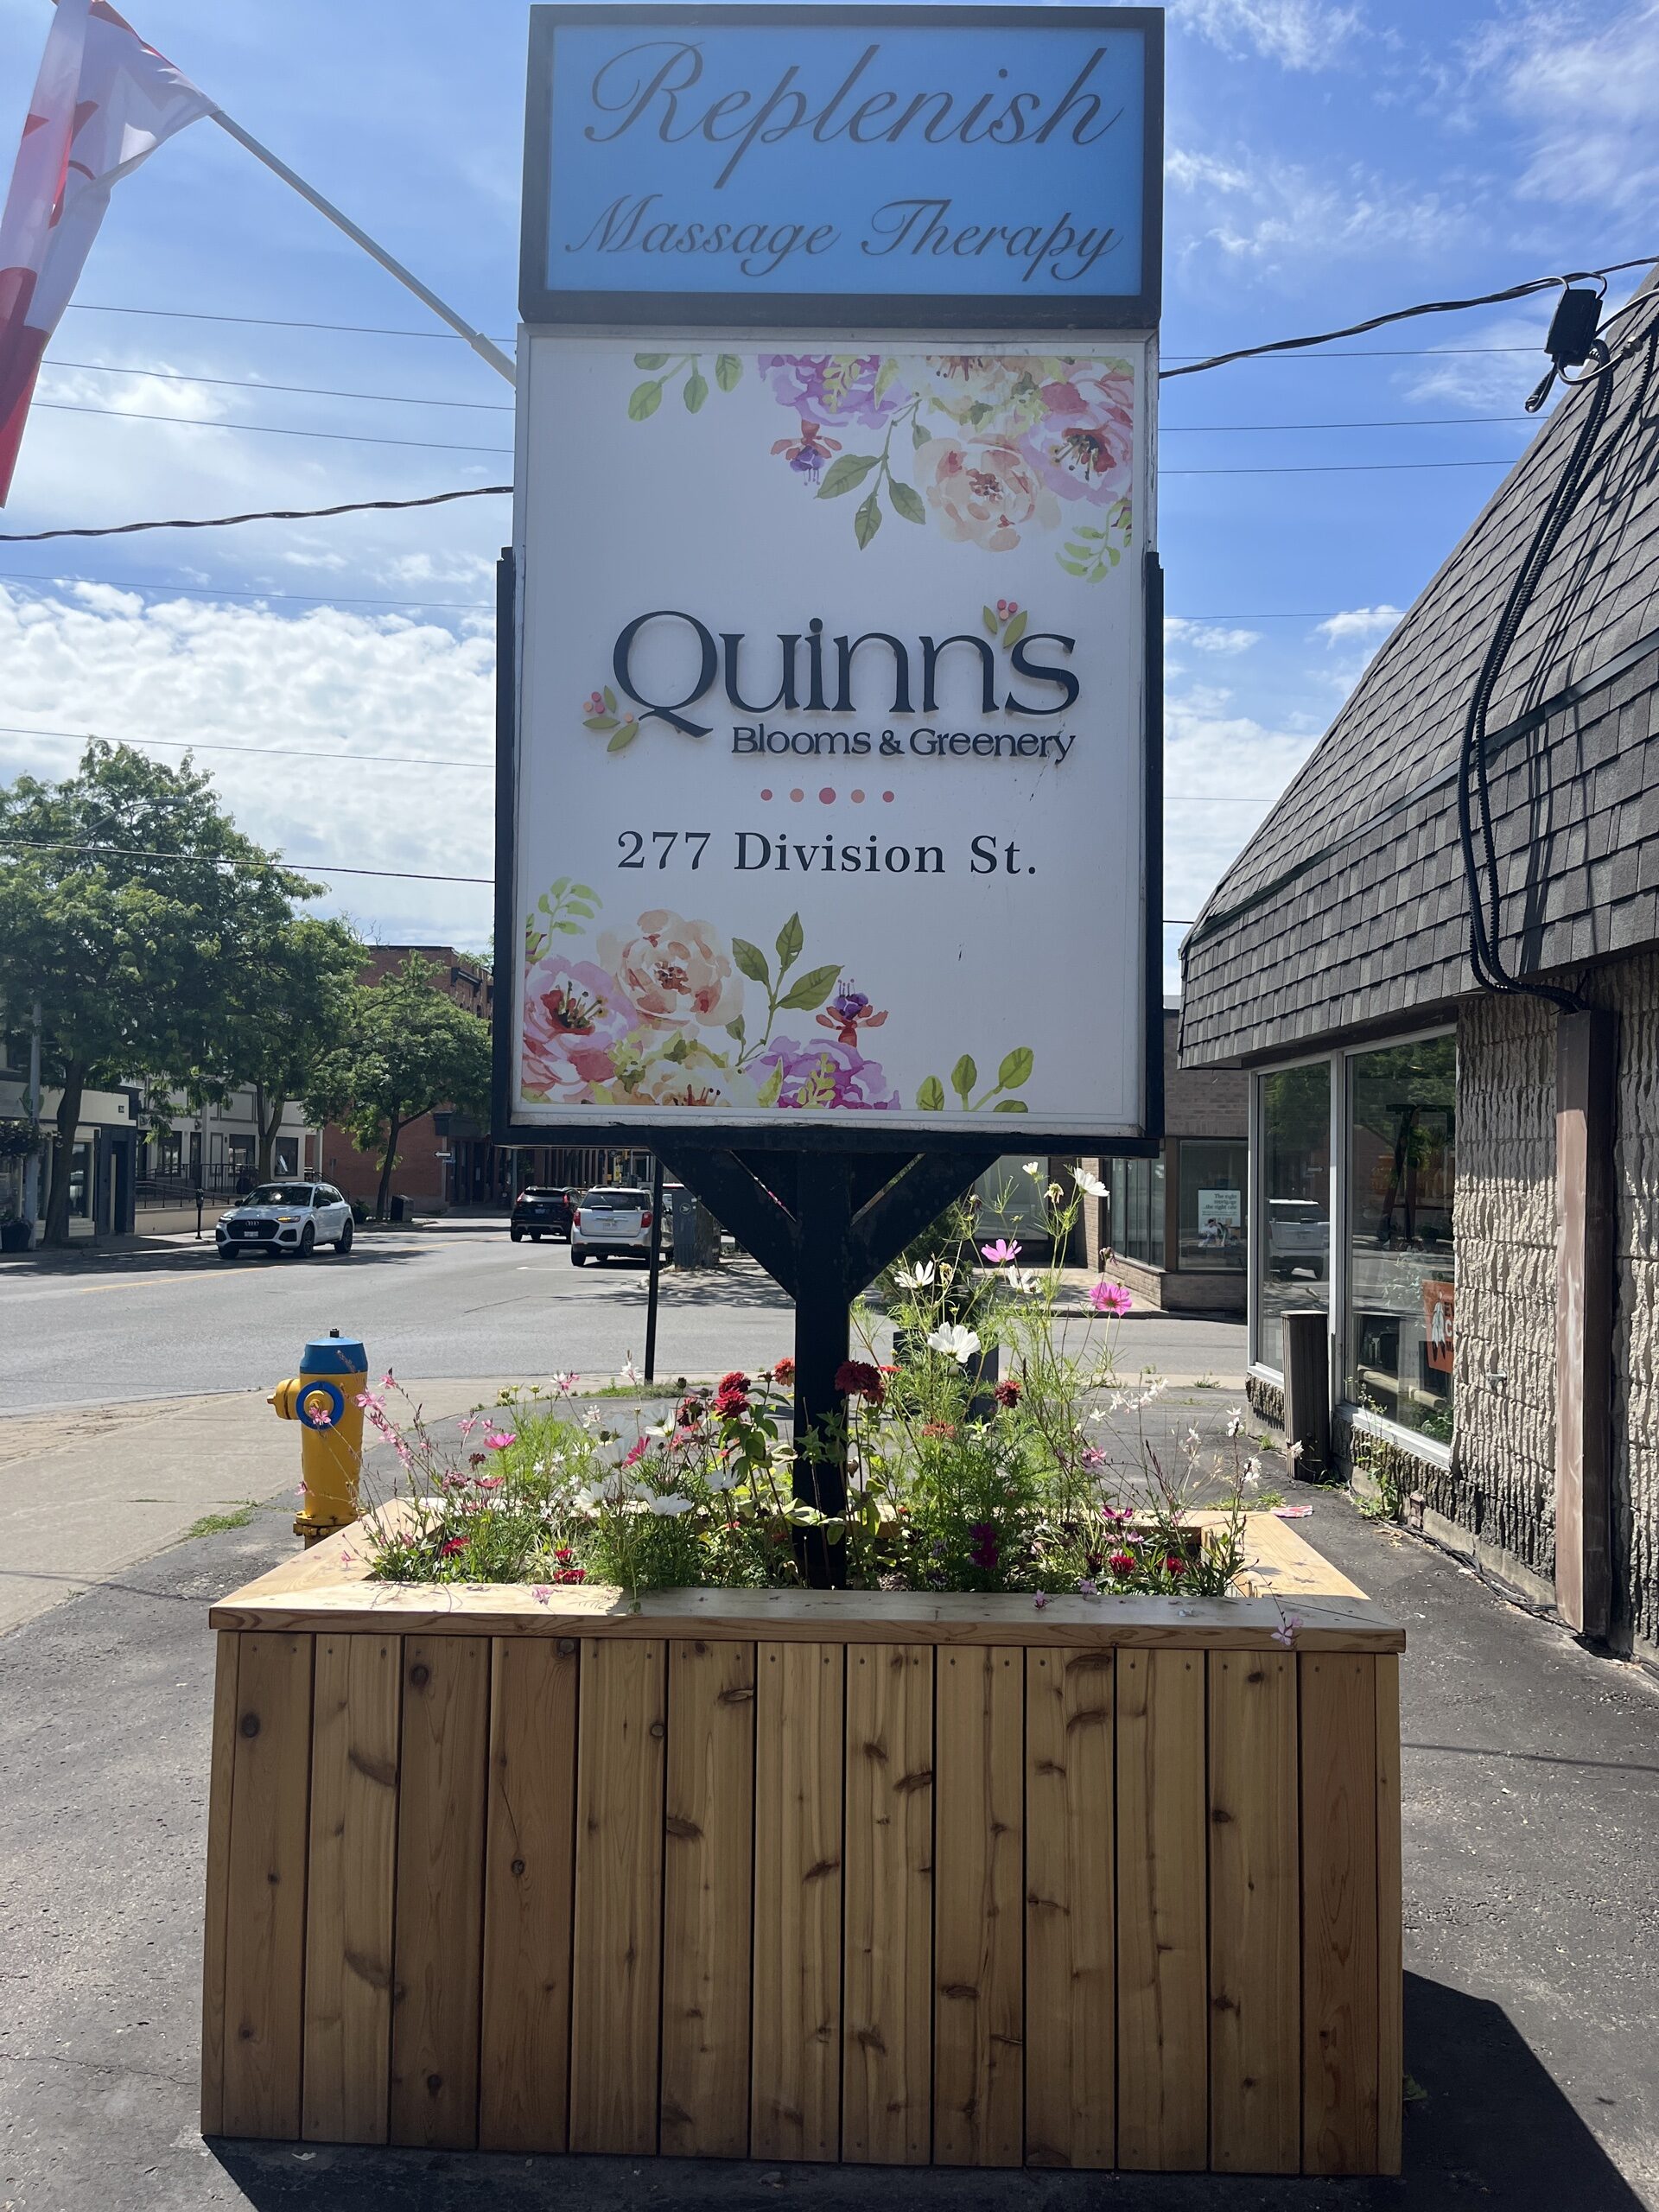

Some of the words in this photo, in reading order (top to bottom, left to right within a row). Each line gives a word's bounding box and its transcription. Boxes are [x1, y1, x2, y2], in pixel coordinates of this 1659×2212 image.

[583, 41, 1124, 189] Replenish
[565, 194, 841, 276] Massage
[861, 199, 1122, 282] Therapy
[731, 723, 871, 755] Blooms
[880, 730, 906, 756] &
[910, 728, 1076, 765] Greenery
[617, 830, 711, 870] 277
[734, 832, 945, 874] Division
[970, 836, 1037, 874] St.
